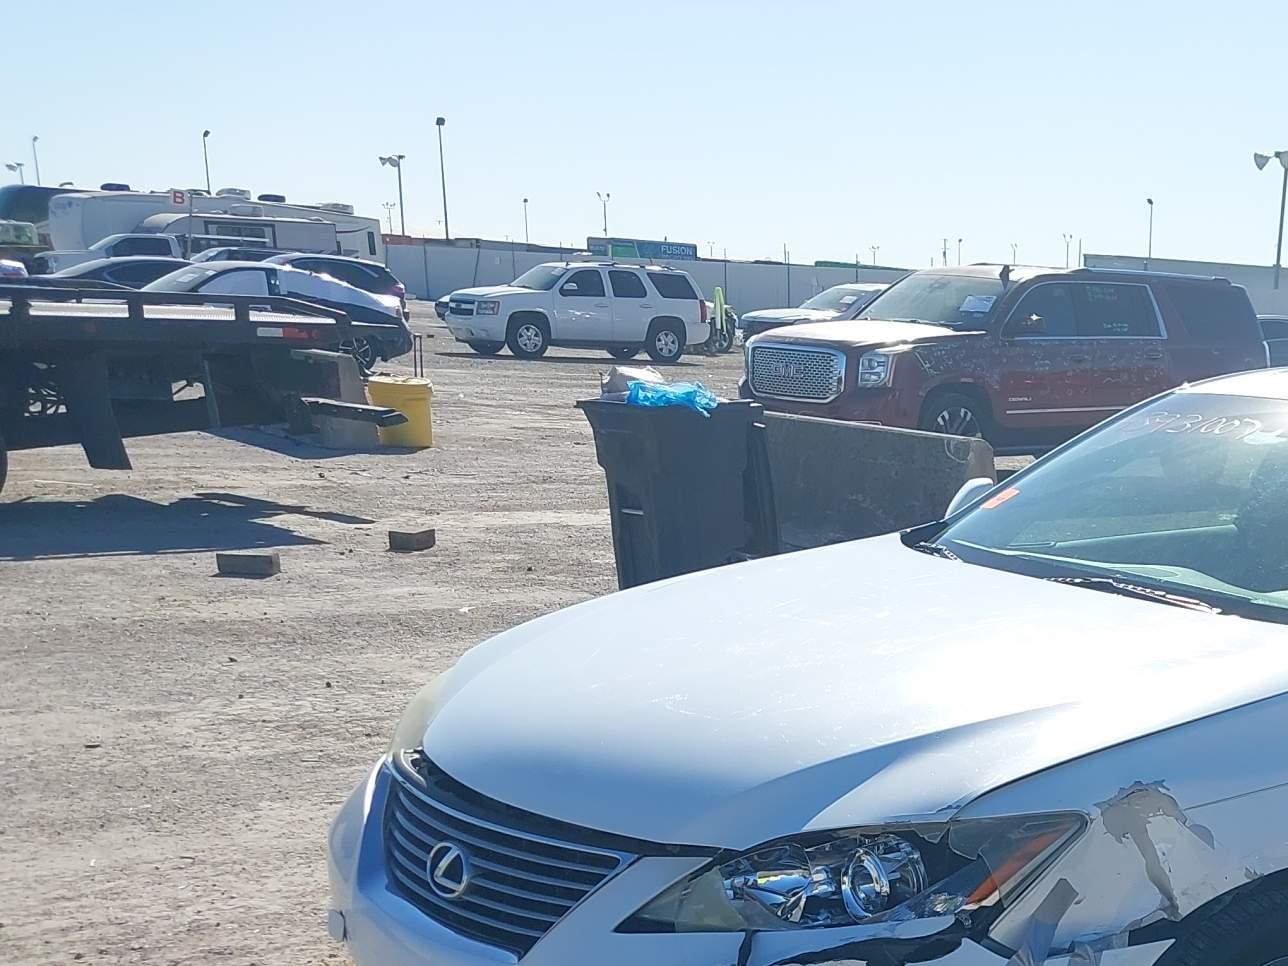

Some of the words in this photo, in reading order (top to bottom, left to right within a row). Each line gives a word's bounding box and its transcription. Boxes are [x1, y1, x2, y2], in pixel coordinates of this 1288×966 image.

[173, 190, 185, 204] B
[661, 244, 693, 256] FUSION
[772, 362, 804, 378] GMC
